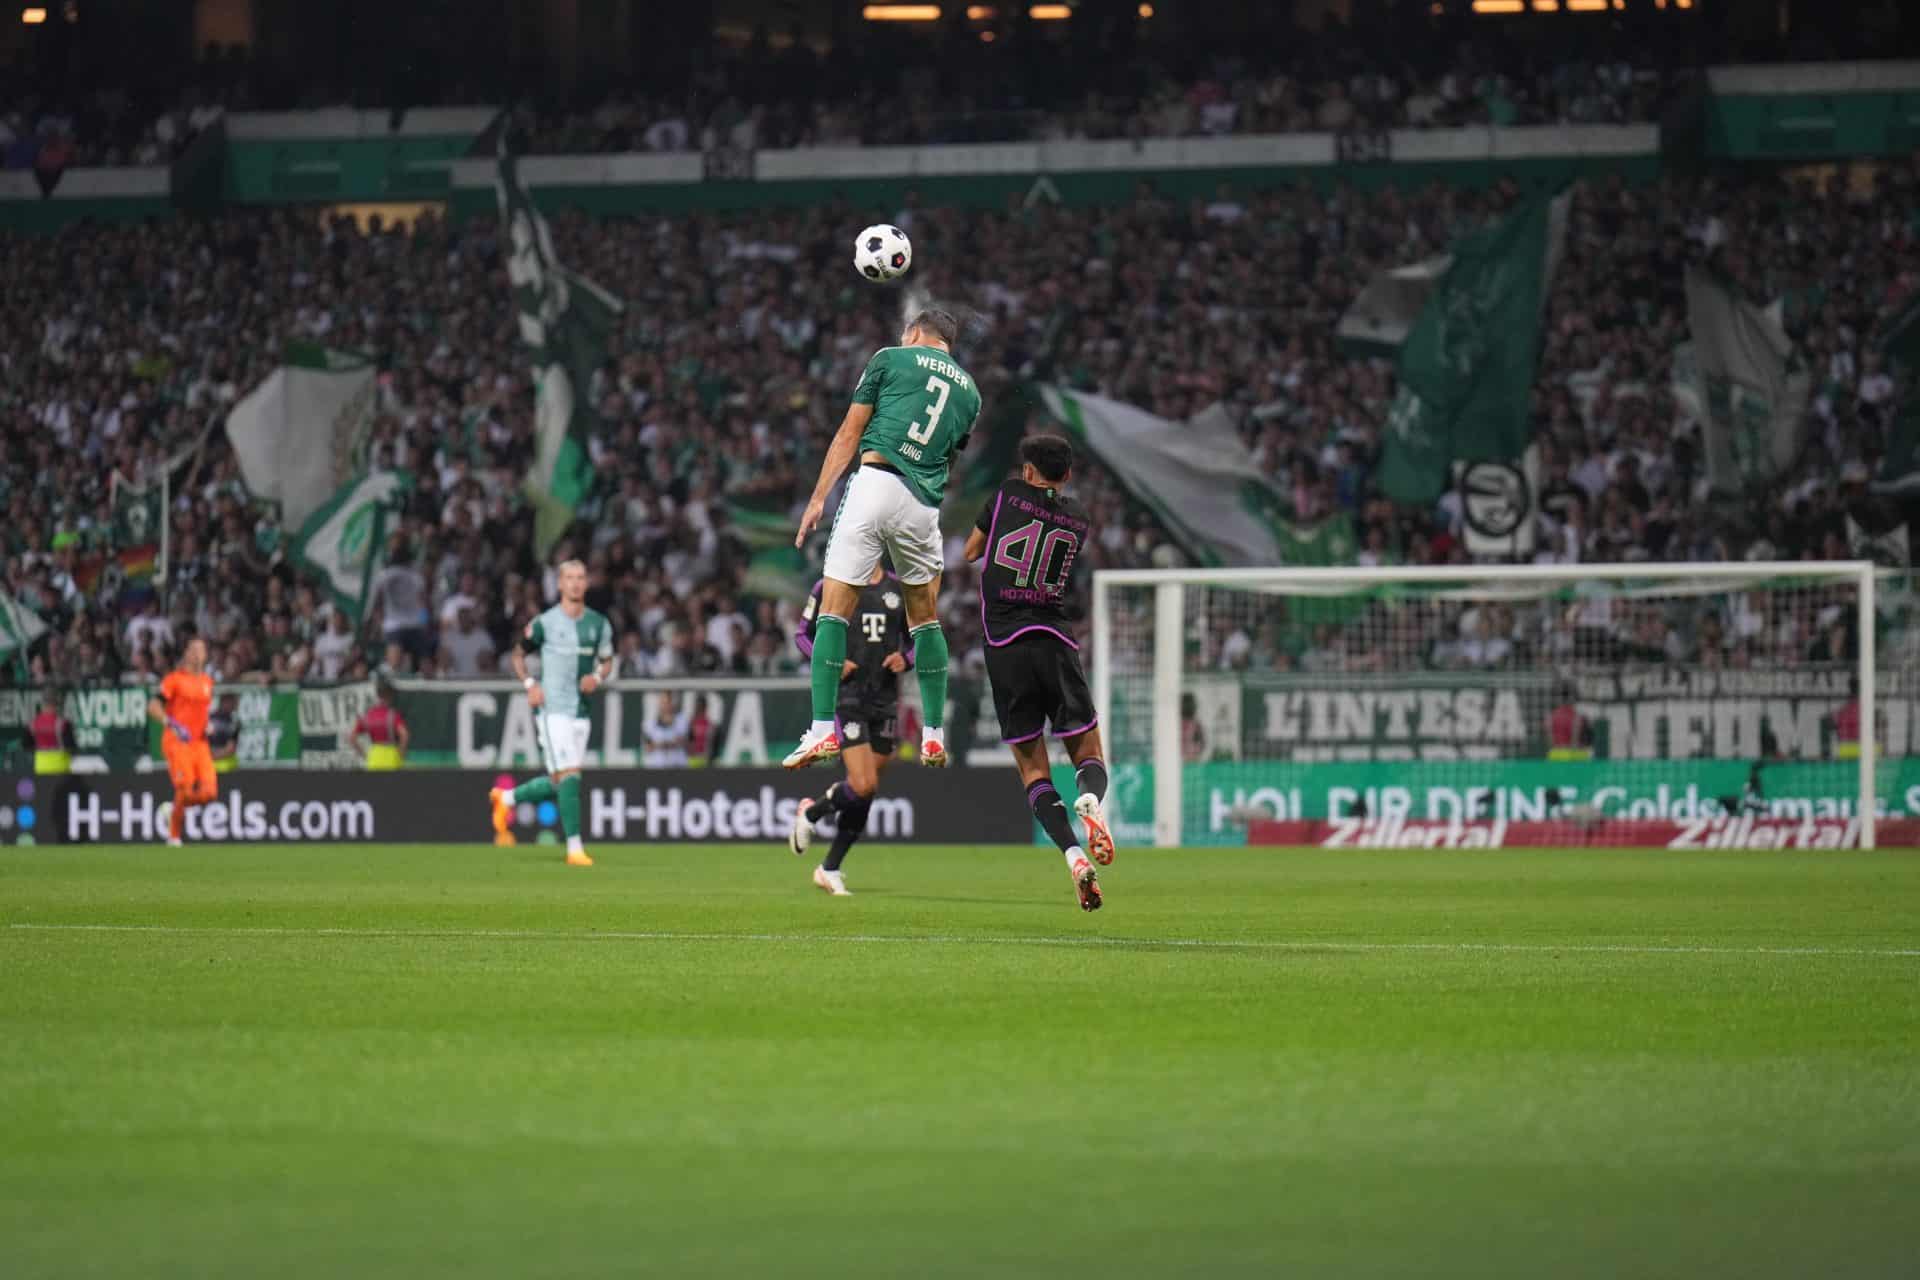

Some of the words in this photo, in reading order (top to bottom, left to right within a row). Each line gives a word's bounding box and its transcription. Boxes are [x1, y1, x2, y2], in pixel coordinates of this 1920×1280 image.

[915, 354, 969, 390] WERDER
[907, 375, 951, 446] 3
[898, 442, 923, 461] JUNG
[994, 519, 1079, 593] 40
[861, 613, 887, 642] T
[590, 786, 913, 838] H-Hotelsm
[1320, 816, 1507, 849] Zillertal
[1667, 814, 1862, 850] Zillertal
